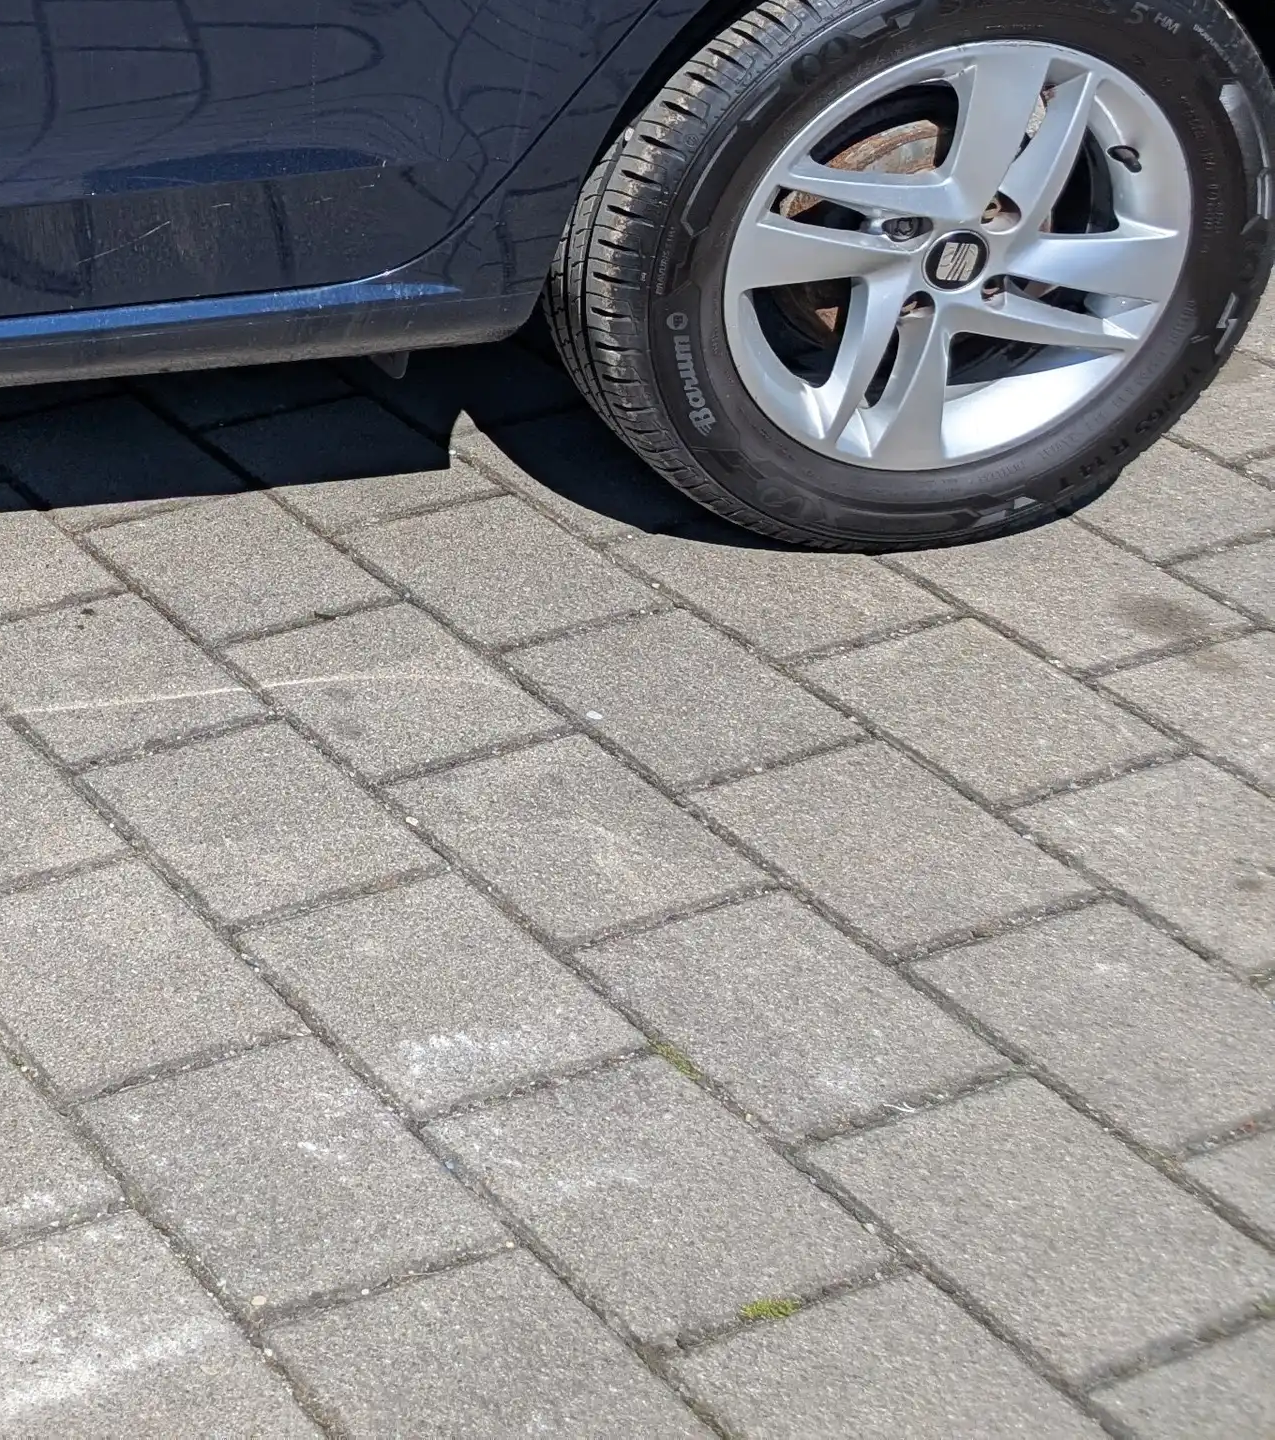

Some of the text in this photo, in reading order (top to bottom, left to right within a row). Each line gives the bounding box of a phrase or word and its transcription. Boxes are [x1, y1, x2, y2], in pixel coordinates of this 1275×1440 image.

[1124, 1, 1151, 24] 5
[1154, 11, 1182, 35] HM
[673, 335, 717, 437] Barum
